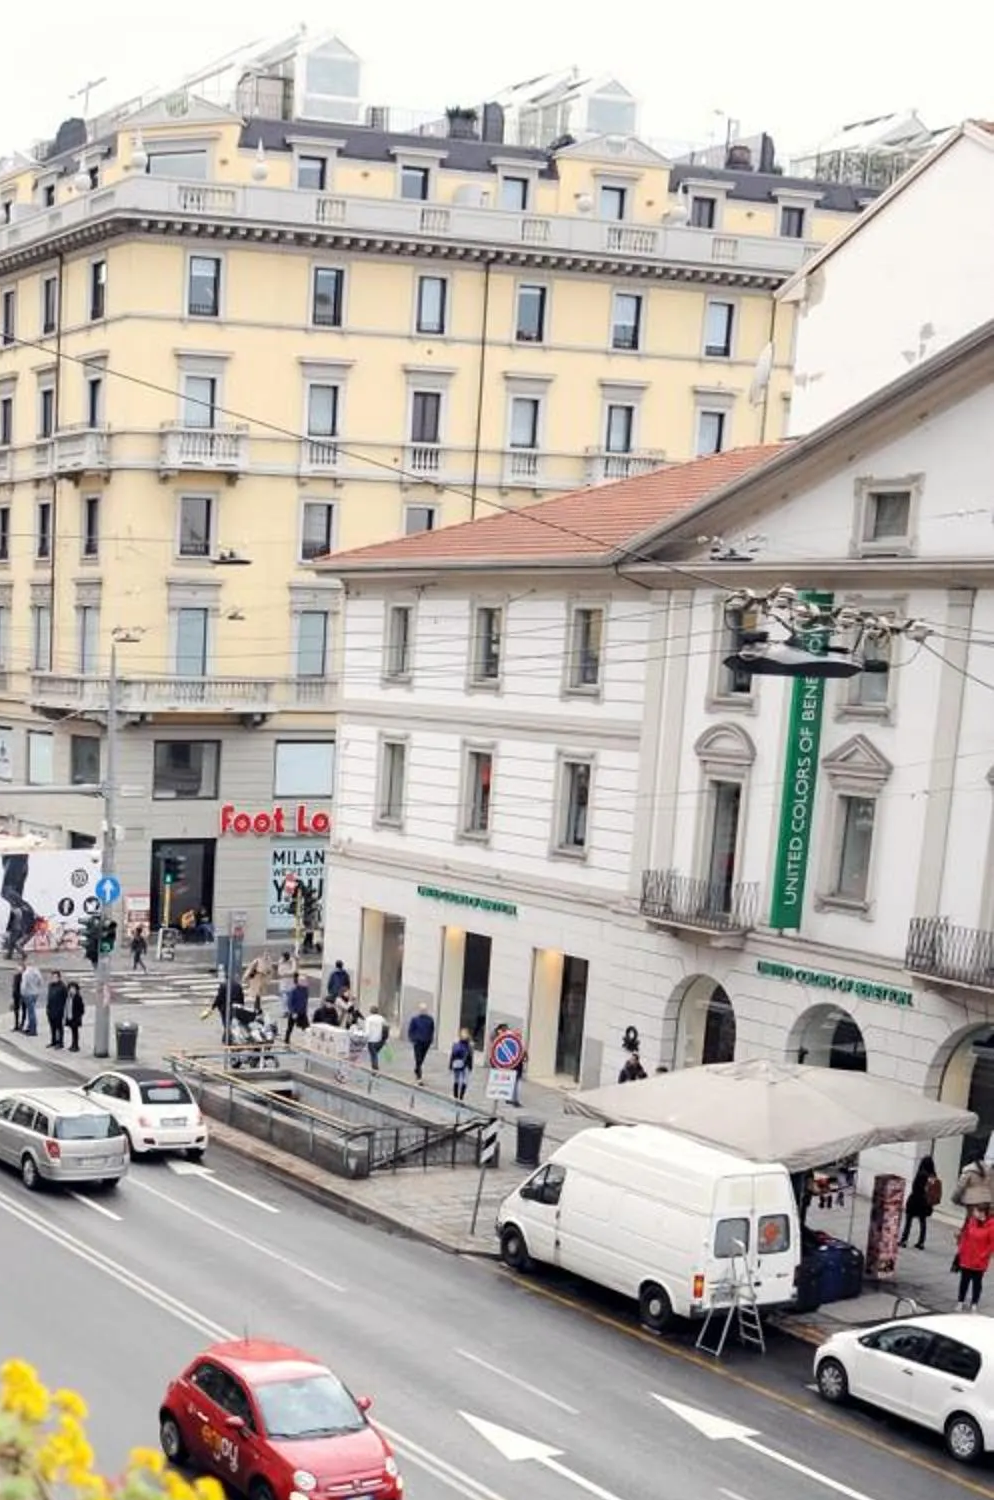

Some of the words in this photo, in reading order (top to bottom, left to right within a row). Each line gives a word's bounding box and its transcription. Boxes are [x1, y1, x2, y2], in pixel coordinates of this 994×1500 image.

[799, 726, 814, 752] OF
[791, 756, 811, 832] COLORS
[221, 804, 285, 834] Foot
[272, 850, 325, 866] MILAN
[783, 836, 803, 906] UNITED
[272, 878, 324, 902] YU
